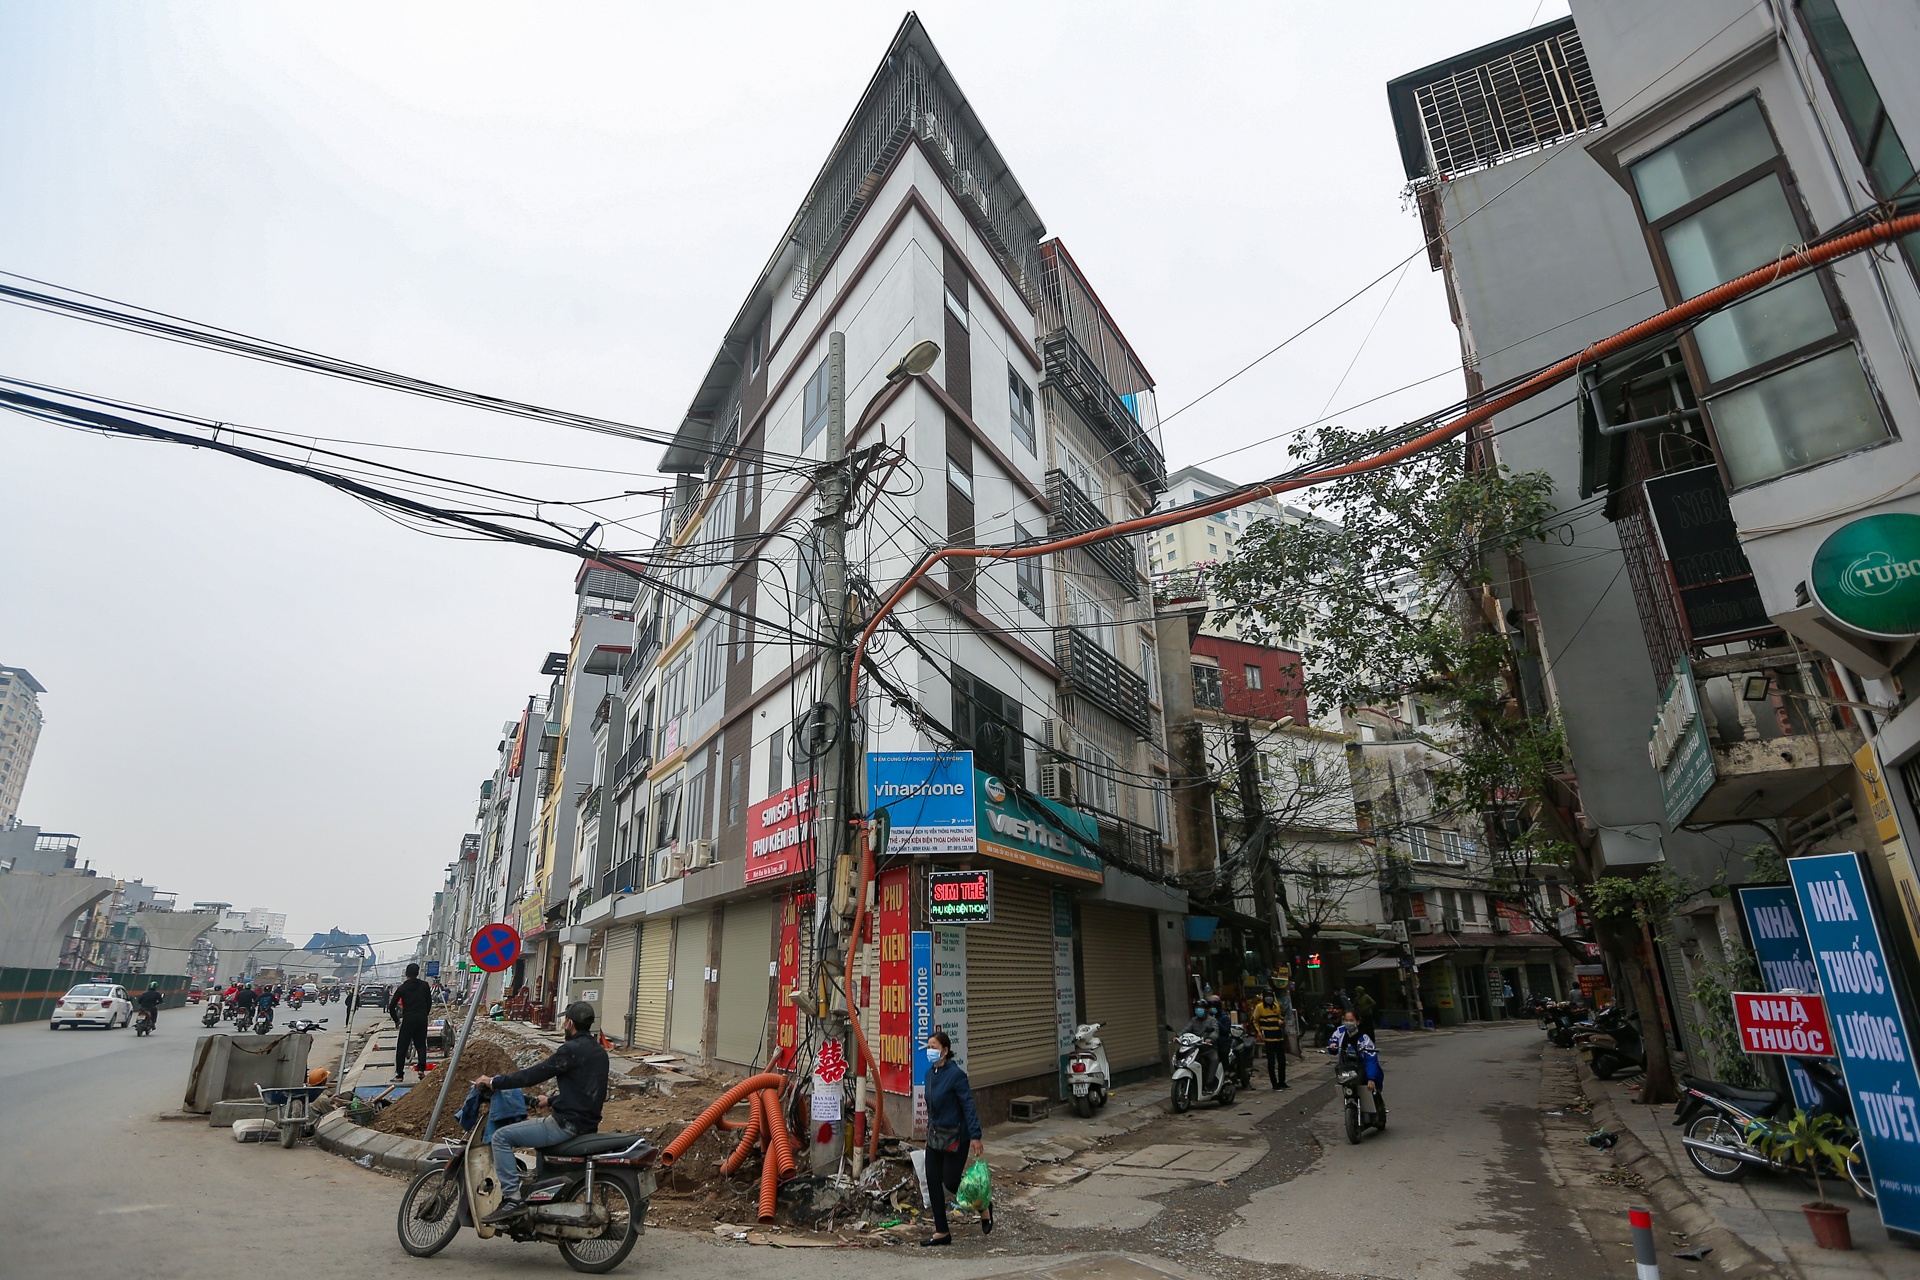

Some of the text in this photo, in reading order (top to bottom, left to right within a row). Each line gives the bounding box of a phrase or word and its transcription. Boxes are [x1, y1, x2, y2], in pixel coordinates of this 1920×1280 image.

[874, 781, 964, 798] vinaphone
[884, 884, 903, 916] PHỤ
[934, 876, 985, 901] SIM THẺ
[1806, 870, 1858, 922] NHÀ
[784, 904, 796, 926] SIM
[1754, 899, 1800, 938] NHÀ
[784, 936, 794, 966] SỐ
[882, 928, 906, 967] KIỆN
[1820, 936, 1884, 994] THUỐC
[1763, 948, 1820, 993] THUỐC
[882, 979, 906, 1019] ĐIỆN
[914, 967, 930, 1050] vinaphone
[1750, 996, 1810, 1022] NHÀ
[780, 1019, 794, 1048] CÀO
[880, 1034, 908, 1071] THOẠI
[1746, 1022, 1824, 1052] THUỐC
[1836, 1010, 1905, 1062] LƯƠNG
[1858, 1080, 1920, 1144] TUYẾT
